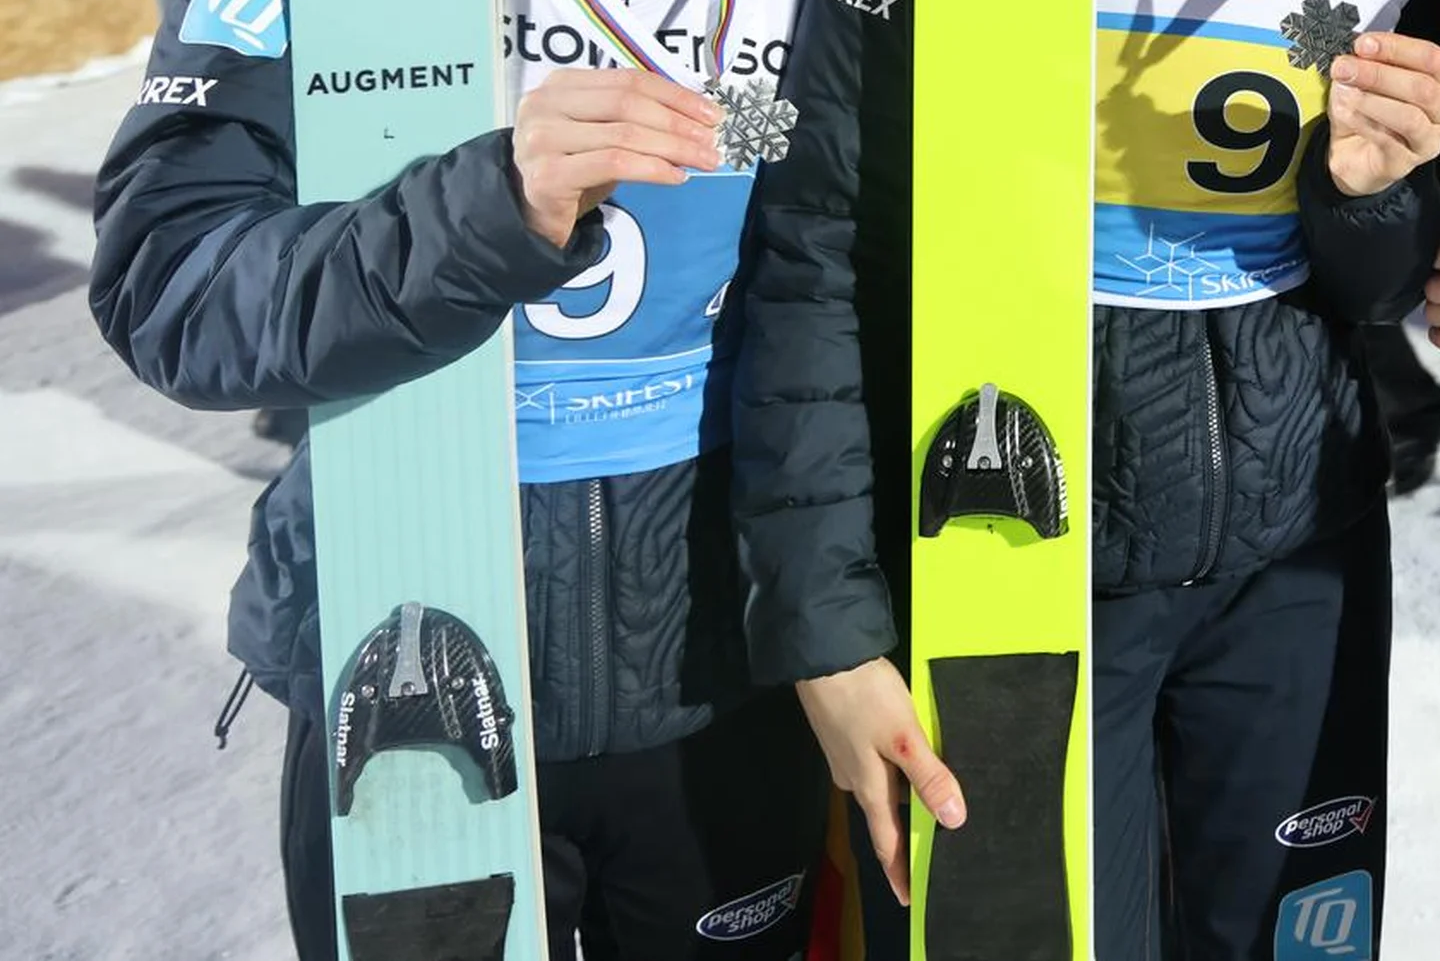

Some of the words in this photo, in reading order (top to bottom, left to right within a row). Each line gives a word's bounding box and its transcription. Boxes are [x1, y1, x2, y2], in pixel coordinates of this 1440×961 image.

[306, 63, 475, 95] AUGMENT
[1186, 70, 1301, 195] 9
[524, 203, 647, 339] 9
[336, 691, 356, 768] Slatnar
[471, 677, 499, 750] Slatnar
[1284, 800, 1362, 836] personal
[1302, 817, 1345, 839] shop
[707, 881, 793, 931] personal
[727, 904, 776, 933] shop
